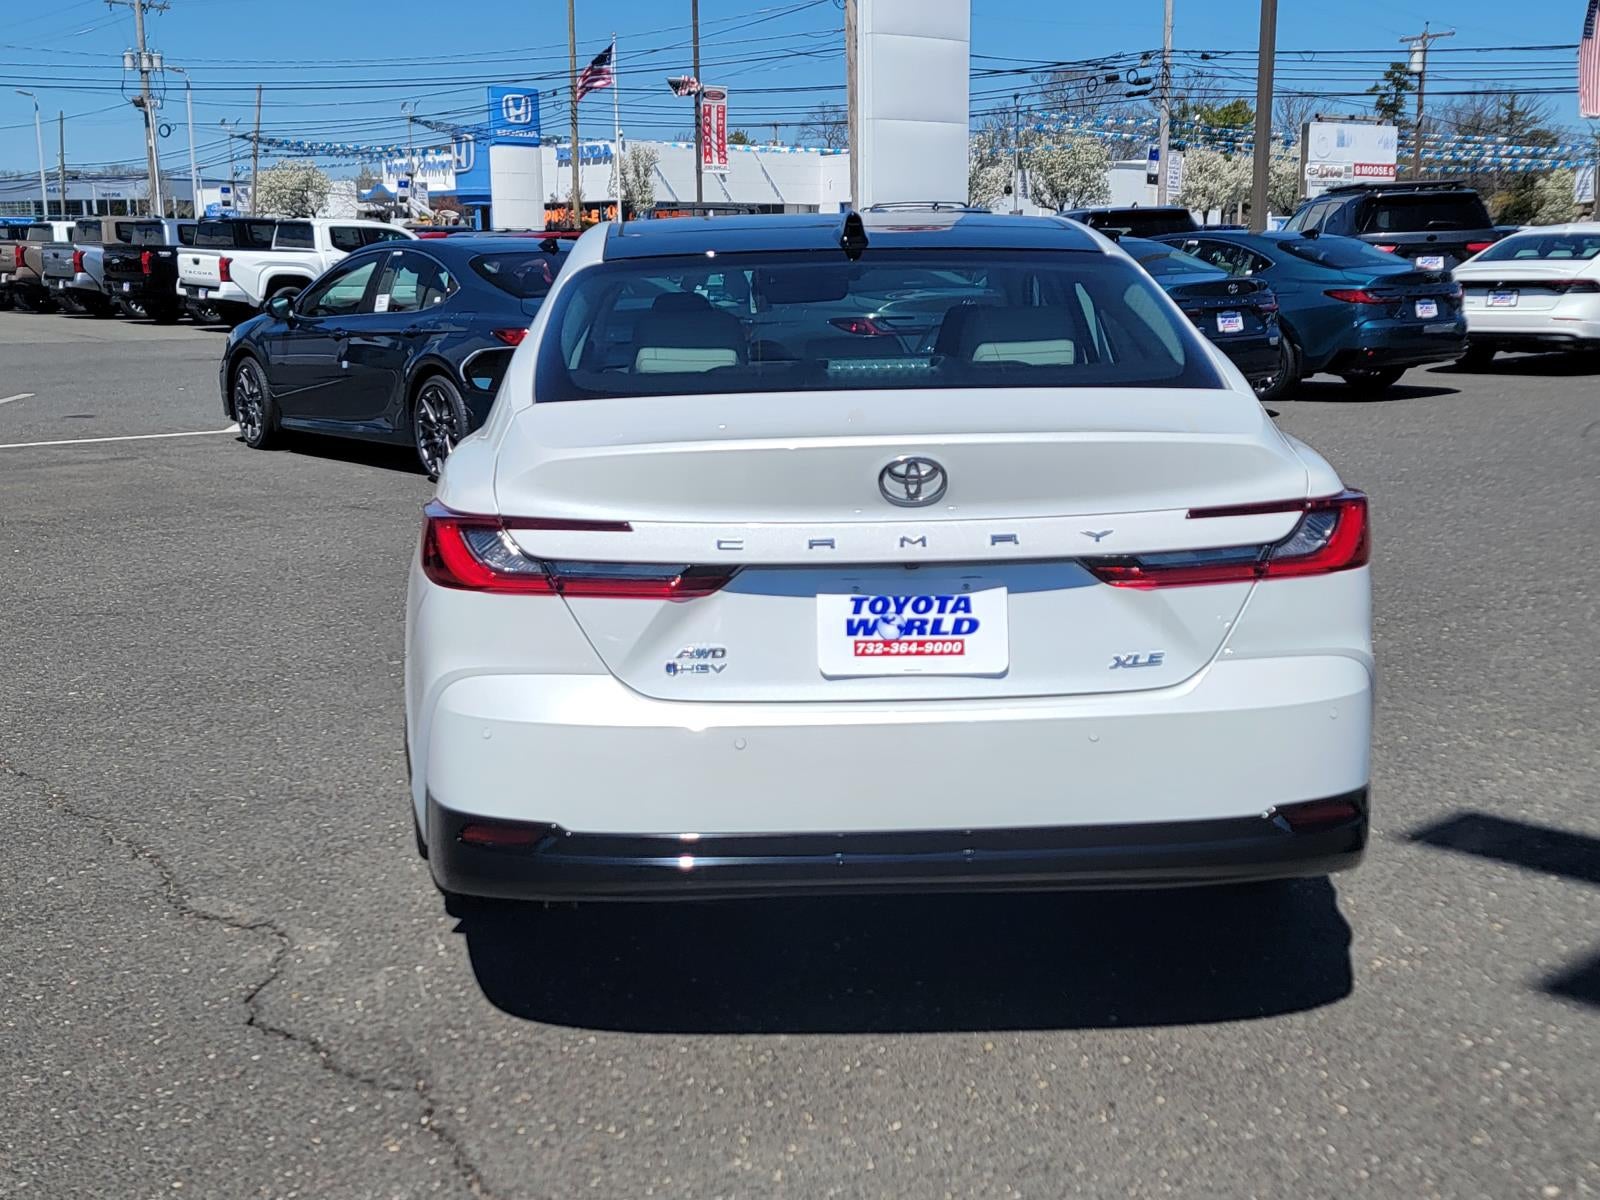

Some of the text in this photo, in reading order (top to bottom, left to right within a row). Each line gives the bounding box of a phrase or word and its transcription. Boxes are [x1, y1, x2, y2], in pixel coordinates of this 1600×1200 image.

[704, 106, 712, 162] TOYOTA
[1361, 165, 1389, 176] MOOSE
[717, 529, 1115, 551] CAMRY
[850, 595, 973, 615] TOYOTA
[676, 647, 727, 659] AWD
[855, 641, 963, 655] 732-364-9000
[1109, 651, 1165, 670] XLE
